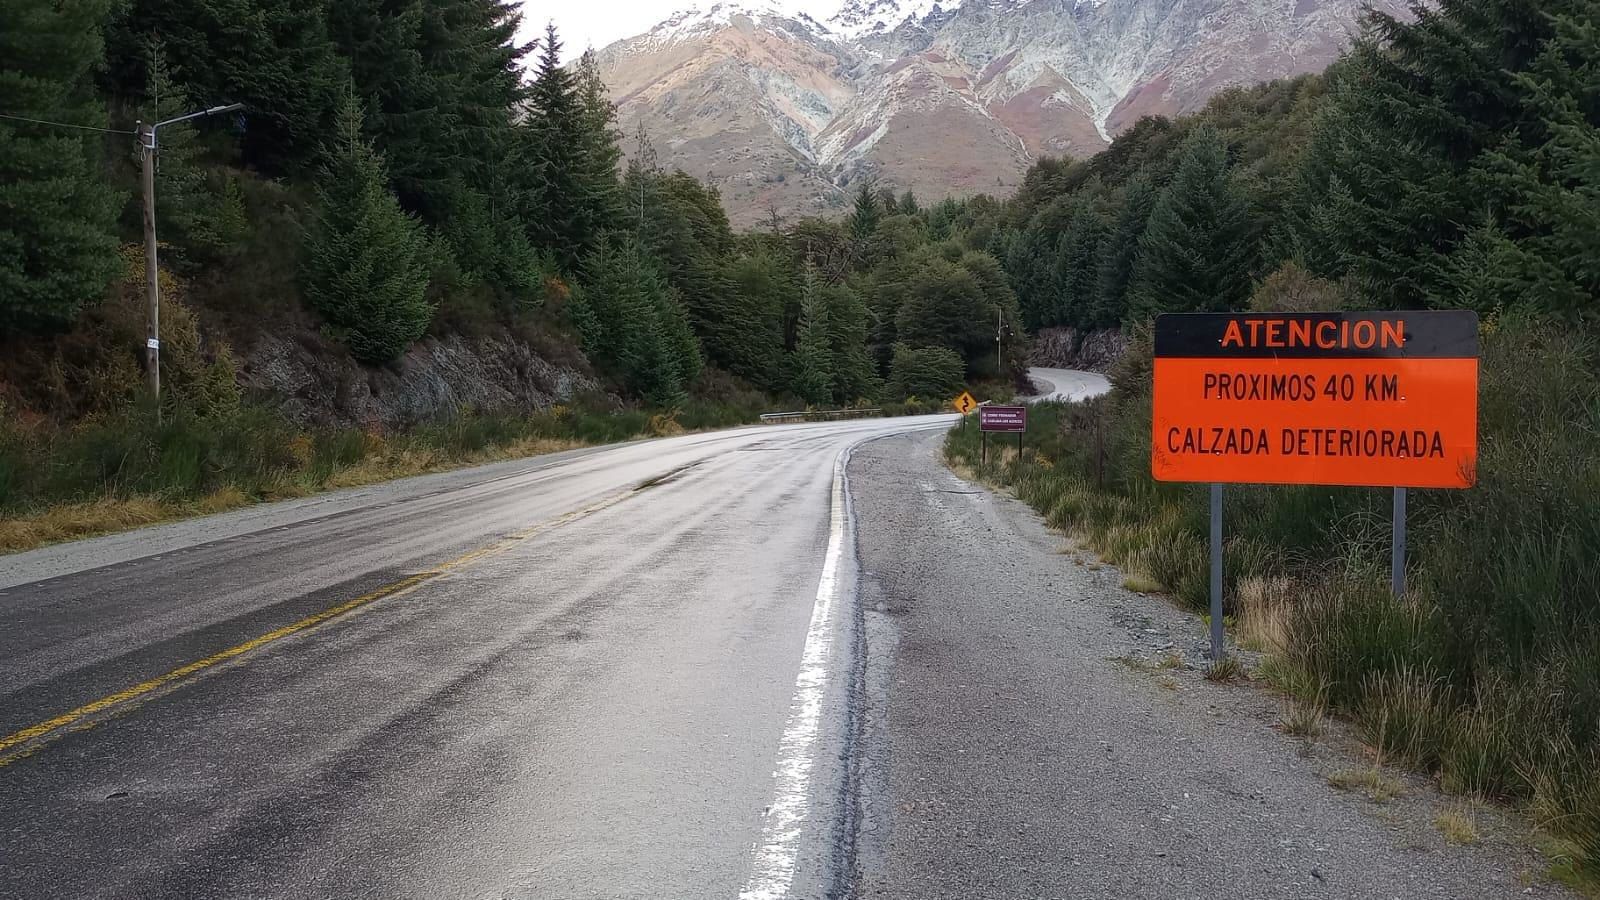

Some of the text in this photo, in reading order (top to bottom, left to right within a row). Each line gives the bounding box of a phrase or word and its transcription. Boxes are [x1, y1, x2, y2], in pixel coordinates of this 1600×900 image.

[1221, 320, 1406, 349] ATENCION
[1204, 374, 1316, 401] PROXIMOS
[1323, 375, 1354, 402] 40
[1168, 427, 1444, 458] CALZADA DETERIORADA
